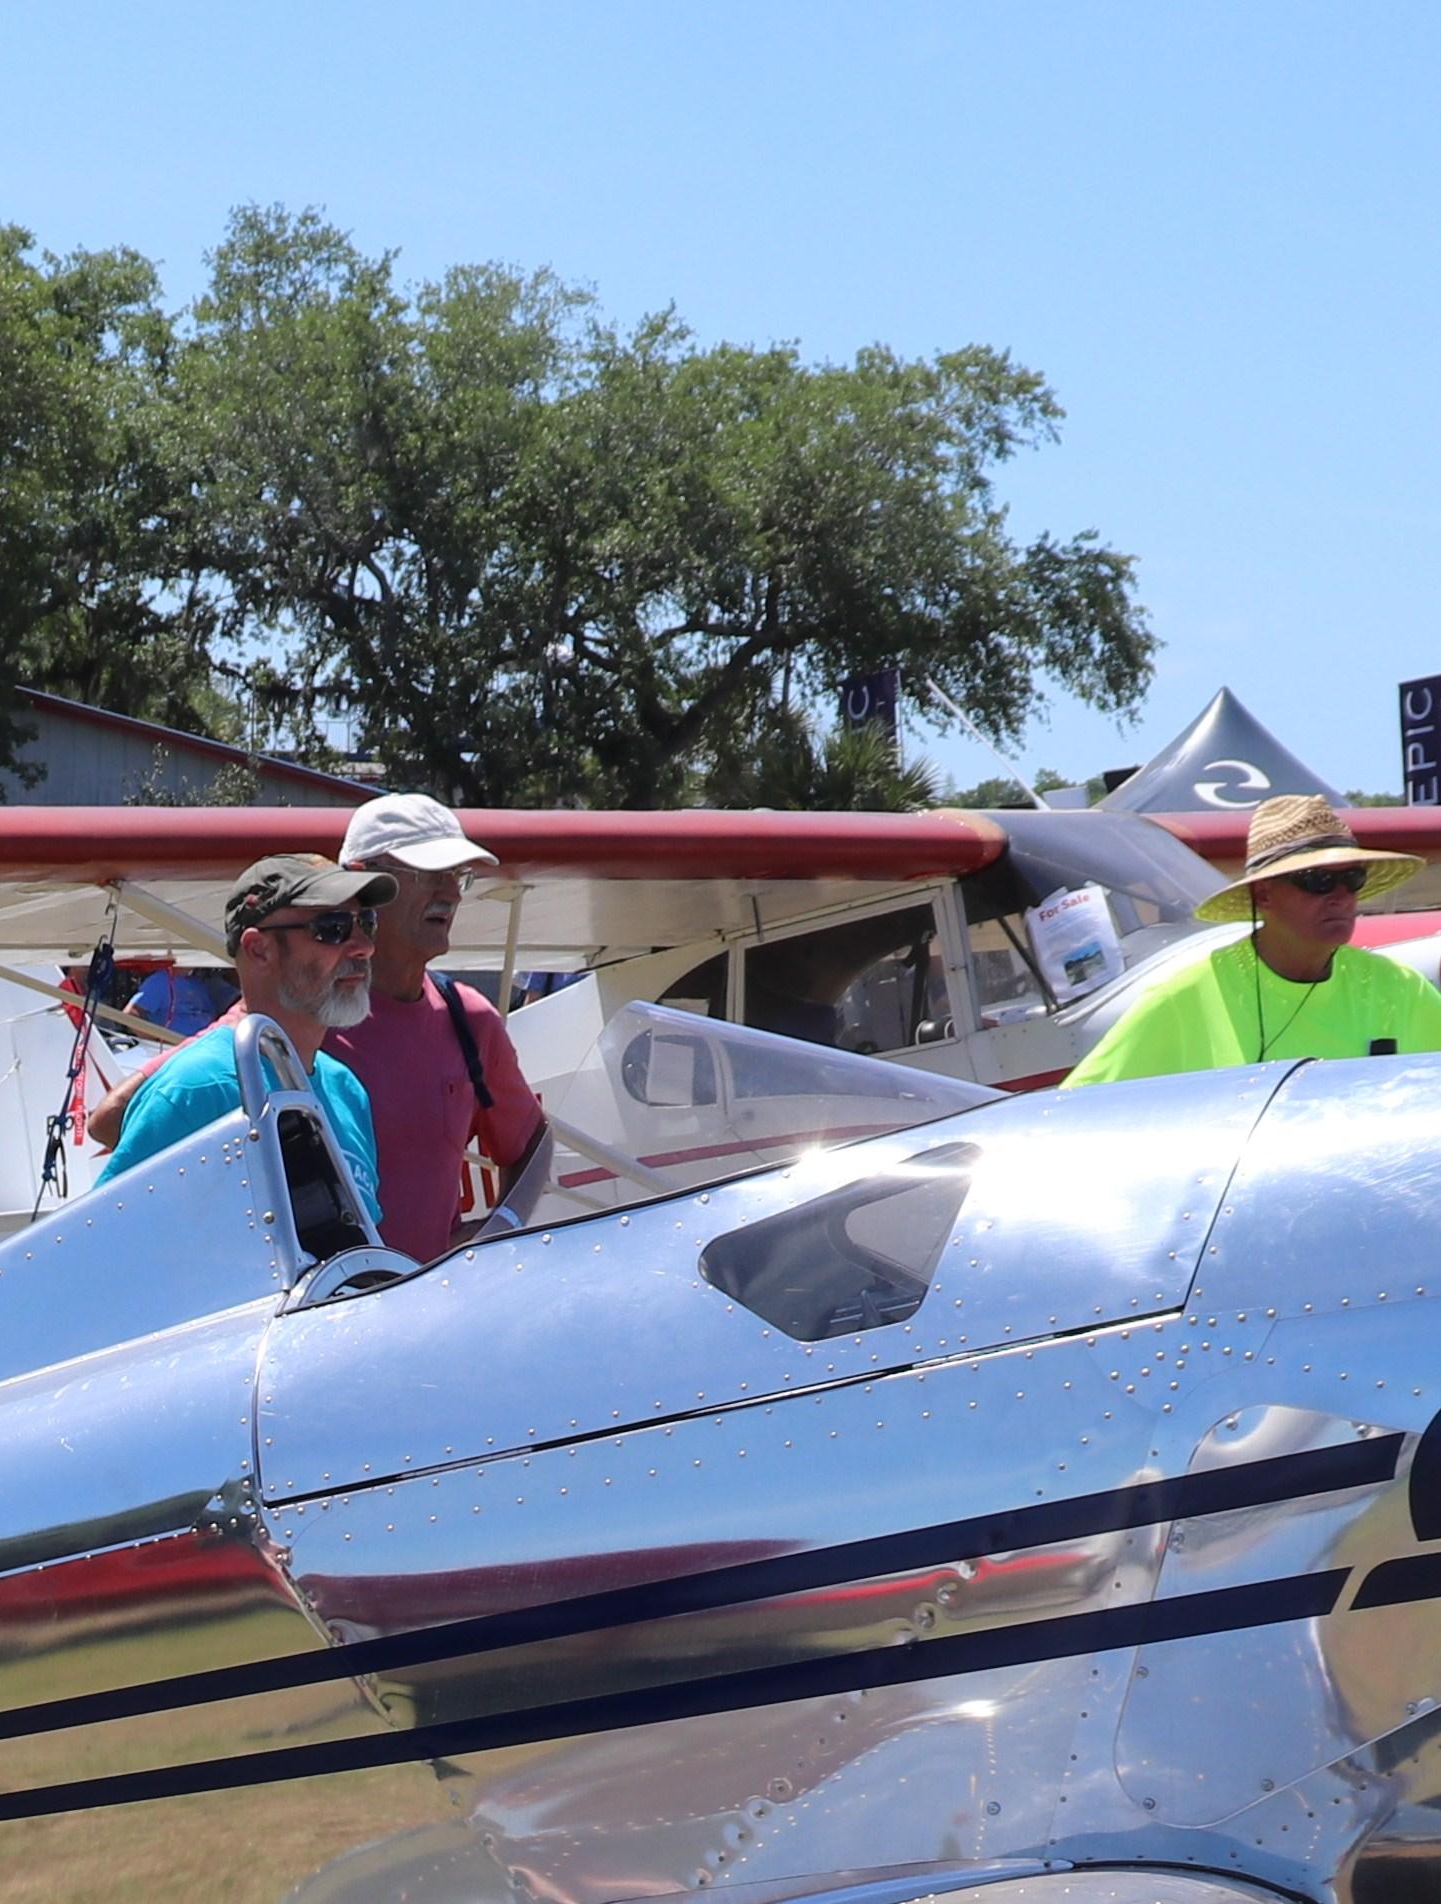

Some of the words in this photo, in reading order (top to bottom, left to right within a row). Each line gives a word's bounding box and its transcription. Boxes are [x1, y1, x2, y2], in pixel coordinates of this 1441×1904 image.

[1406, 686, 1438, 806] EPIC
[1038, 907, 1060, 922] For
[1061, 894, 1090, 910] Sale
